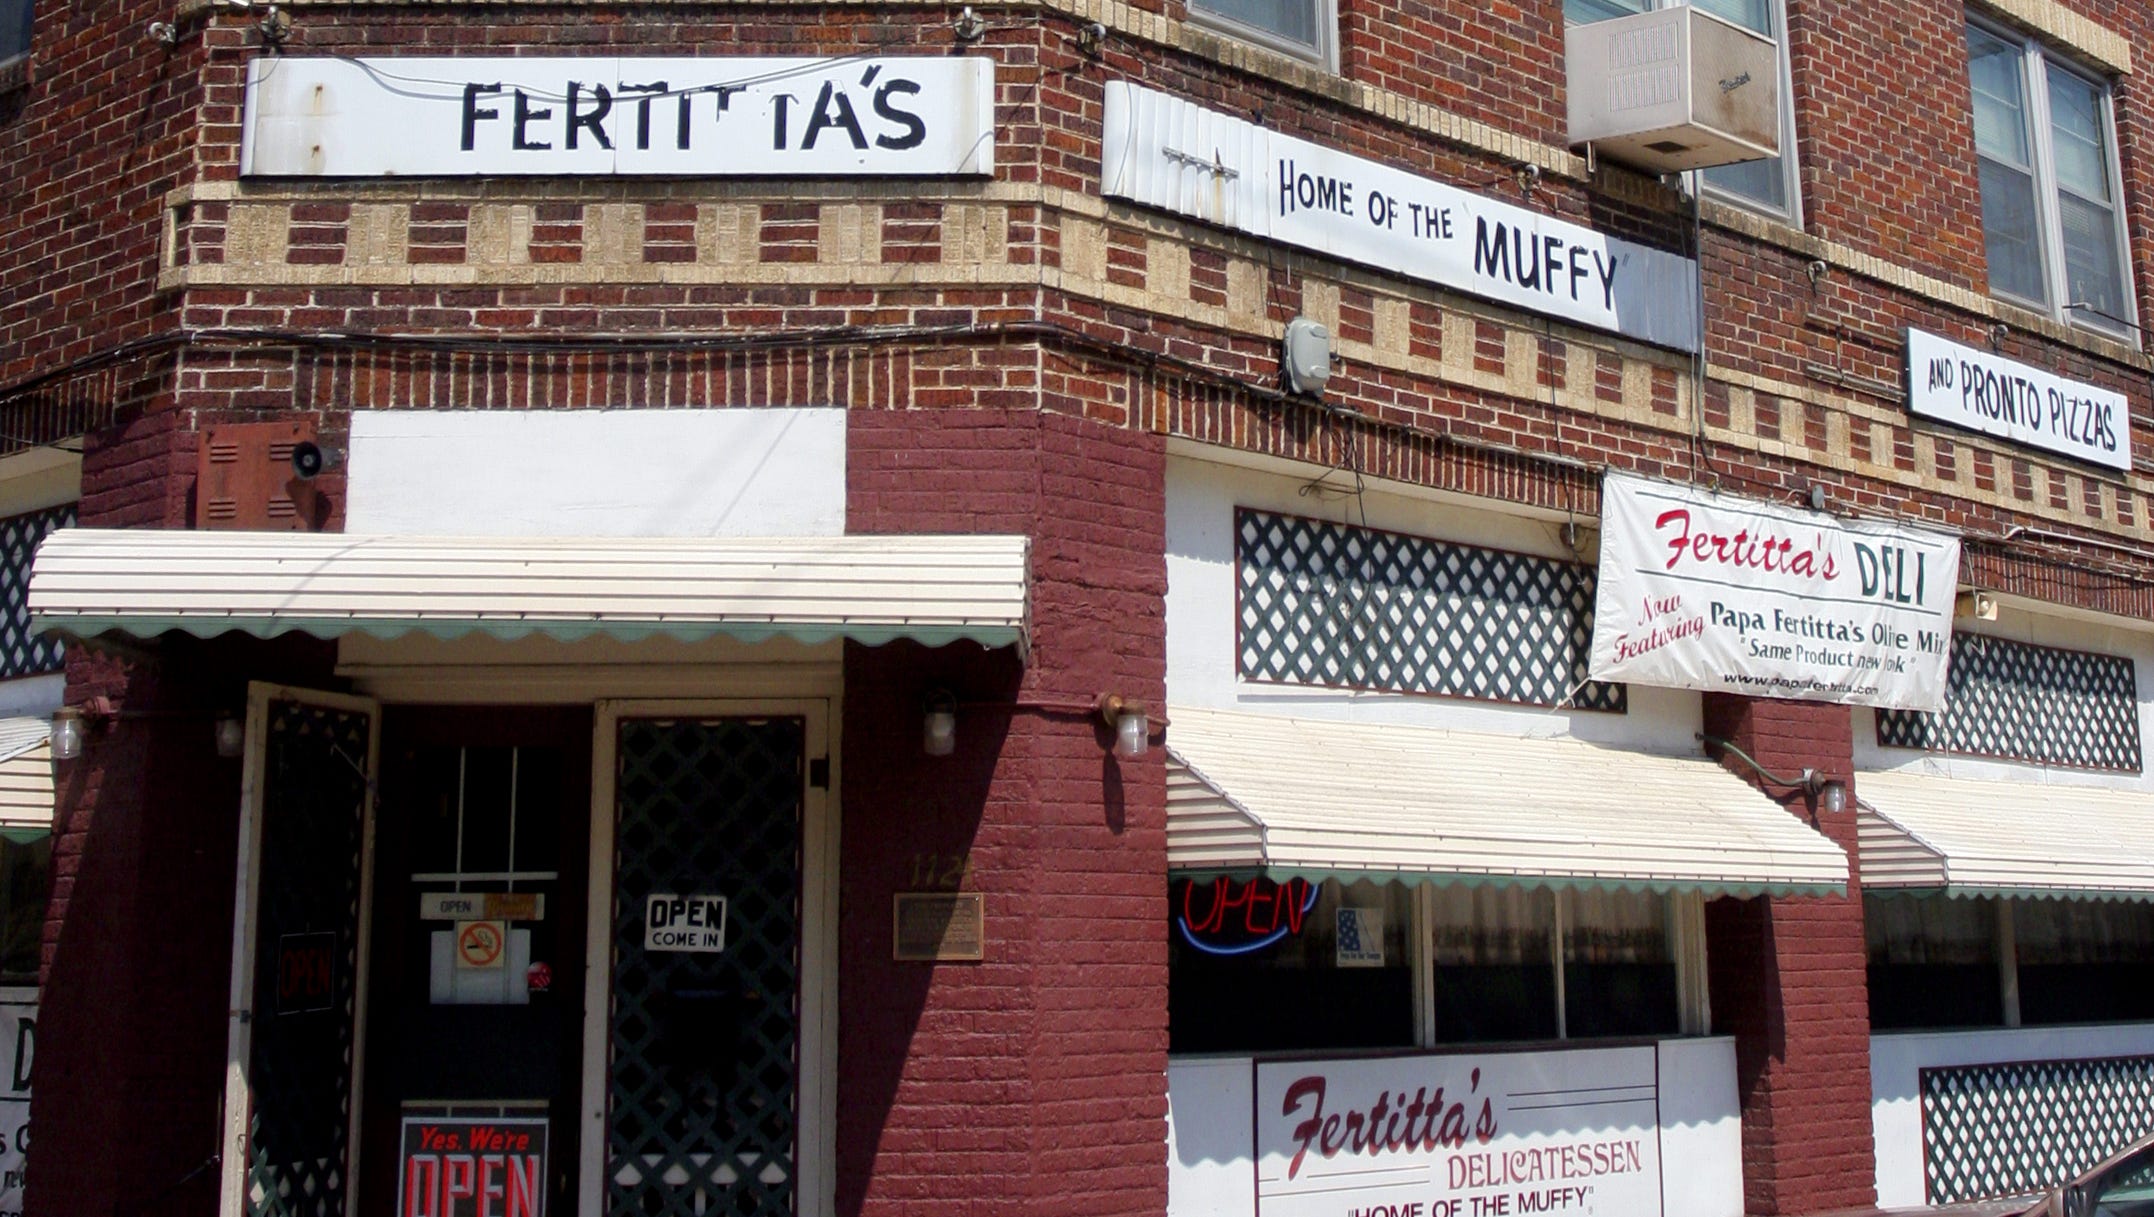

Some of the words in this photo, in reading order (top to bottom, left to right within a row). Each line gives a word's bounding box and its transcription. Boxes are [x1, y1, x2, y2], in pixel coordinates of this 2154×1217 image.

[1279, 158, 1354, 217] HOME
[1368, 190, 1399, 231] OF
[1407, 202, 1454, 239] THE
[1928, 358, 1954, 393] AND
[1655, 508, 1840, 581] Fertitta's
[1853, 541, 1926, 606] DELI
[1638, 594, 1682, 626] Now
[1710, 601, 1766, 635] Papa
[1773, 608, 1865, 643] Fertitta's
[1871, 622, 1909, 650] Olie
[1613, 615, 1705, 664] Featuring
[1796, 644, 1853, 667] Product
[440, 901, 471, 913] OPEN
[650, 899, 722, 930] OPEN
[1184, 876, 1308, 934] OPEN
[652, 932, 696, 947] COME
[703, 933, 718, 947] IN
[470, 1126, 529, 1151] We're
[1282, 1067, 1497, 1182] Fertitta's
[405, 1154, 540, 1217] OPEN
[1447, 1139, 1642, 1190] DELICATESSEN
[1432, 1199, 1462, 1217] OF
[1469, 1194, 1510, 1217] THE
